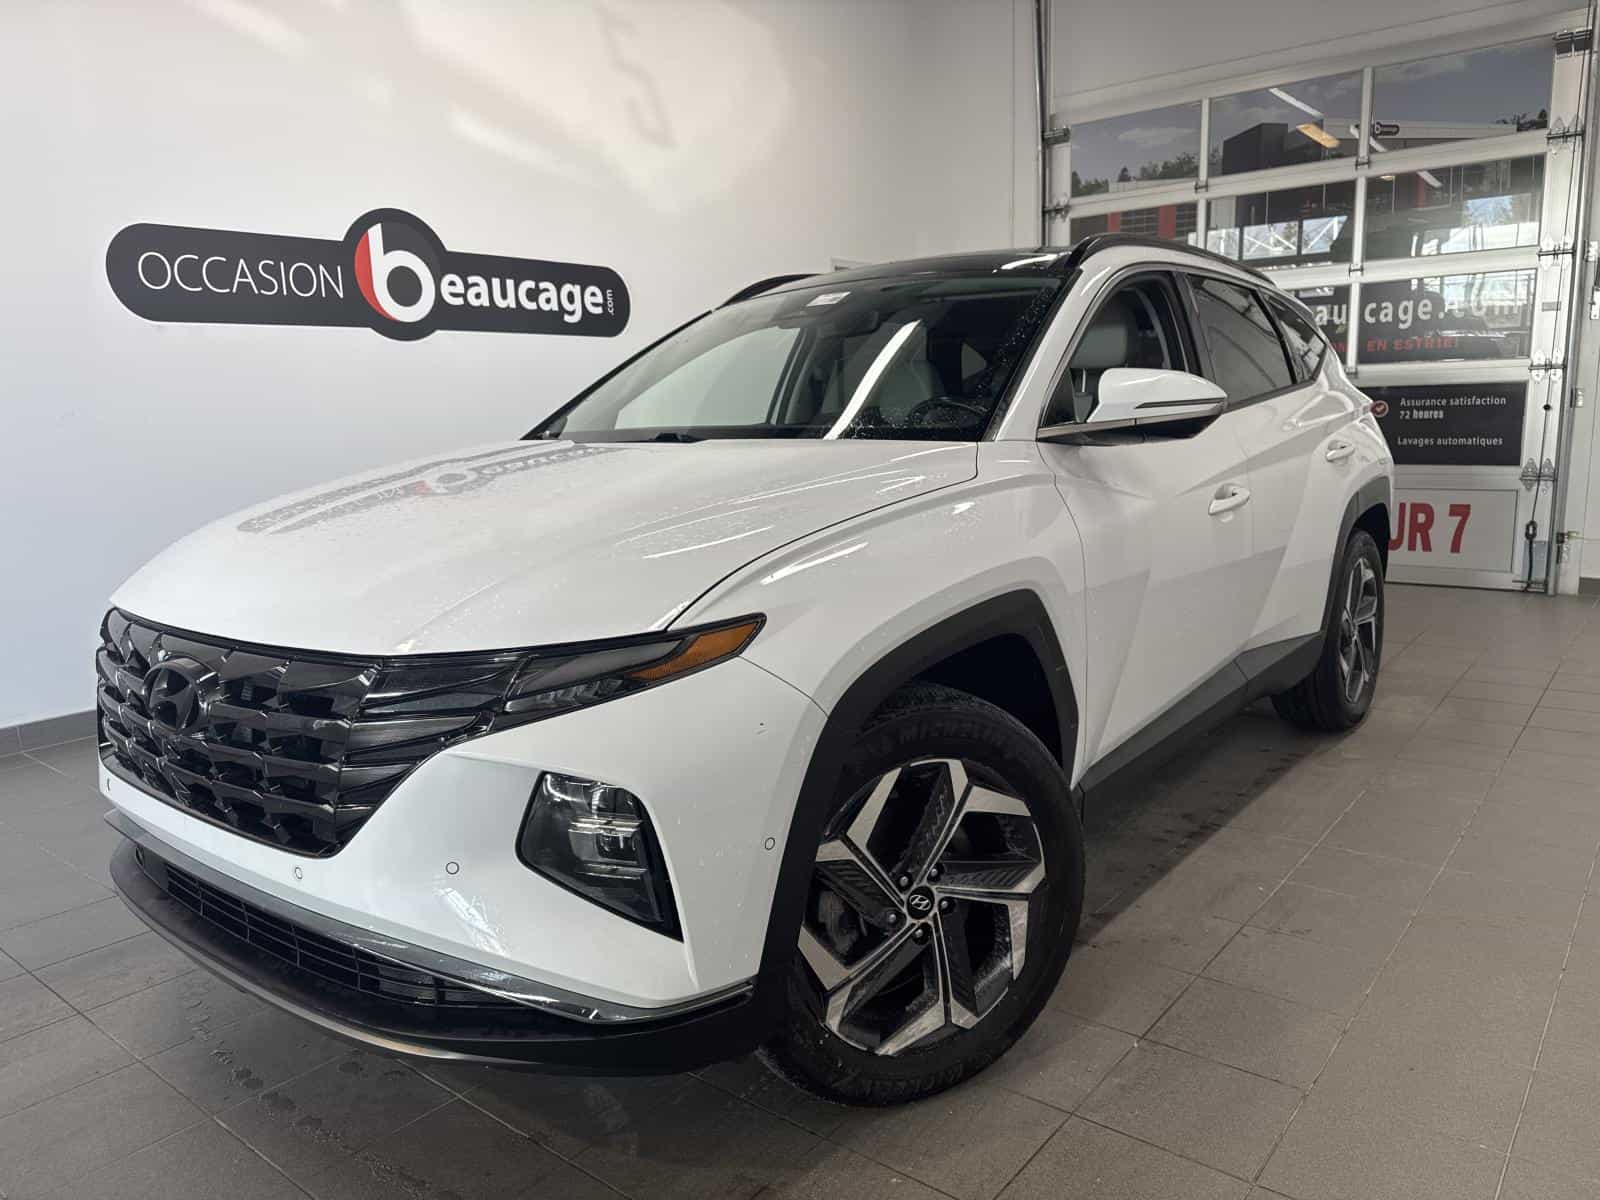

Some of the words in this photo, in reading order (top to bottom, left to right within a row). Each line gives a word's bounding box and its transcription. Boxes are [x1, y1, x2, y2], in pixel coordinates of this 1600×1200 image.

[137, 251, 344, 299] OCCASION
[1367, 339, 1388, 351] EN
[1400, 397, 1447, 407] Assurance
[1450, 395, 1506, 406] satisfaction
[1399, 410, 1411, 420] 72
[1412, 409, 1444, 419] heures
[1397, 436, 1435, 448] Lavages
[1437, 436, 1503, 448] automatiques
[1448, 504, 1471, 554] 7
